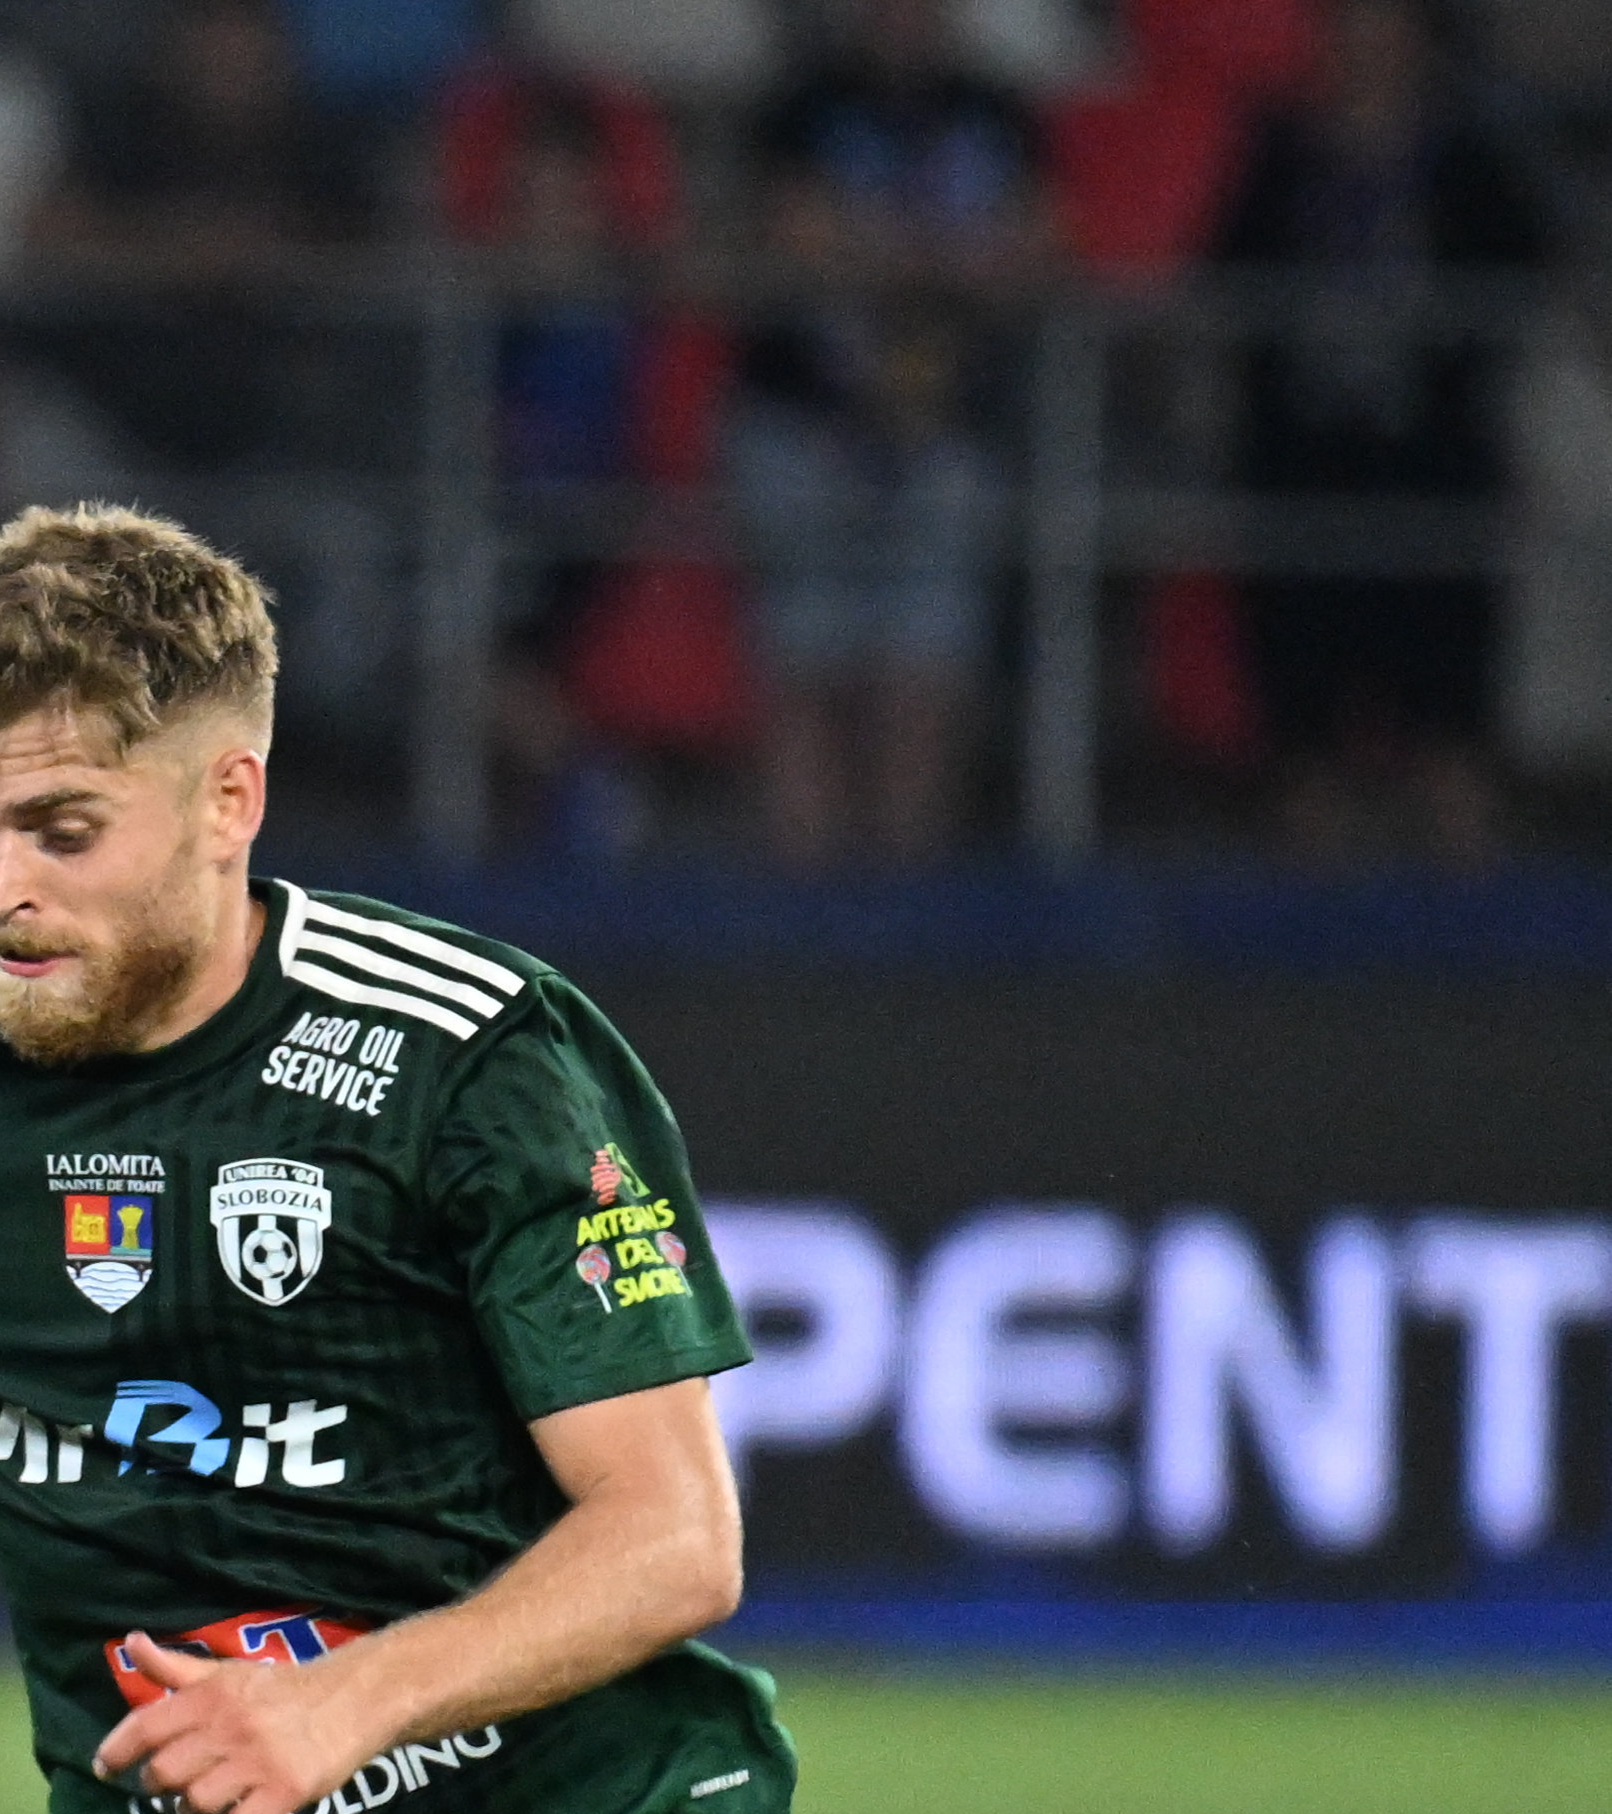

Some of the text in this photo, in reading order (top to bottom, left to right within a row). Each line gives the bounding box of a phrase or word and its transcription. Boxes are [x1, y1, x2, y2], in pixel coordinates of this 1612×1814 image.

[281, 1011, 405, 1073] AGRO OIL
[261, 1045, 395, 1117] SERVICE
[225, 1164, 288, 1183] UNIREA
[106, 1179, 124, 1192] DE
[127, 1179, 166, 1194] TOATE
[217, 1188, 323, 1213] SLOBOZIA
